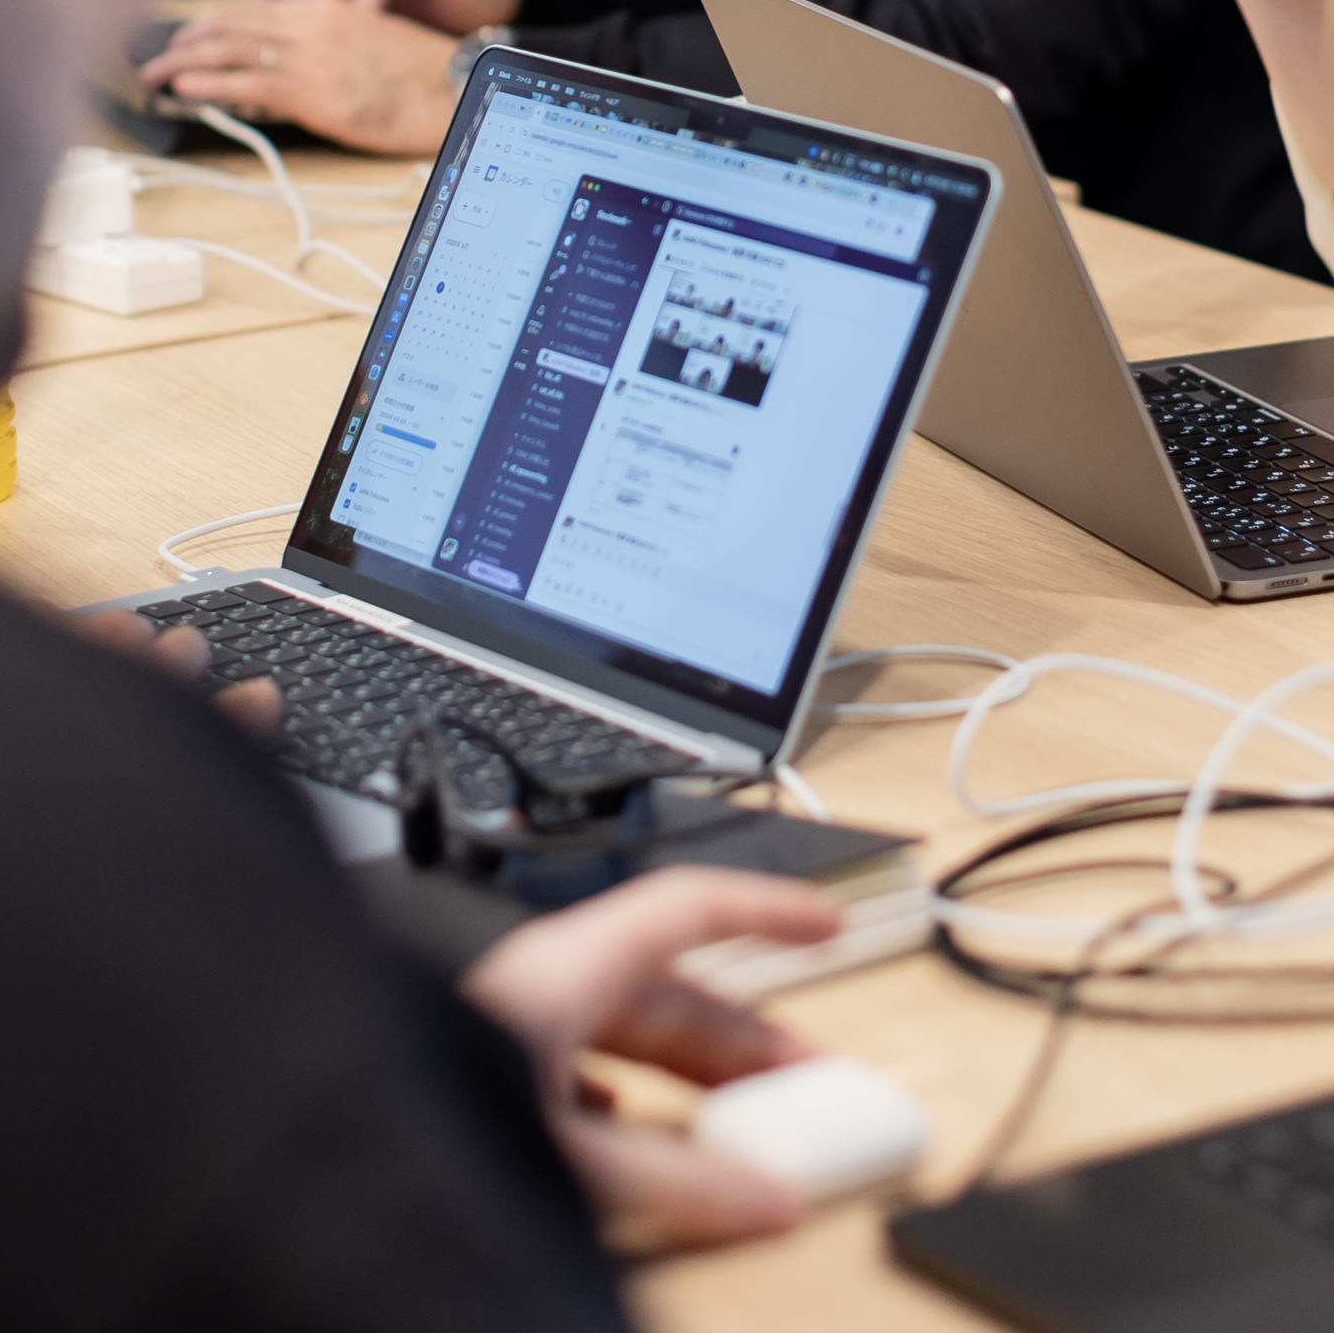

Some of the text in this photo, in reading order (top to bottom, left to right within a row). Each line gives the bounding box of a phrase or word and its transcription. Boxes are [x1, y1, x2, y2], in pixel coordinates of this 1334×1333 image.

[499, 71, 511, 79] Slack
[516, 76, 532, 84] ファイル
[499, 172, 533, 187] カレンダー
[358, 466, 386, 479] マイカレンダー
